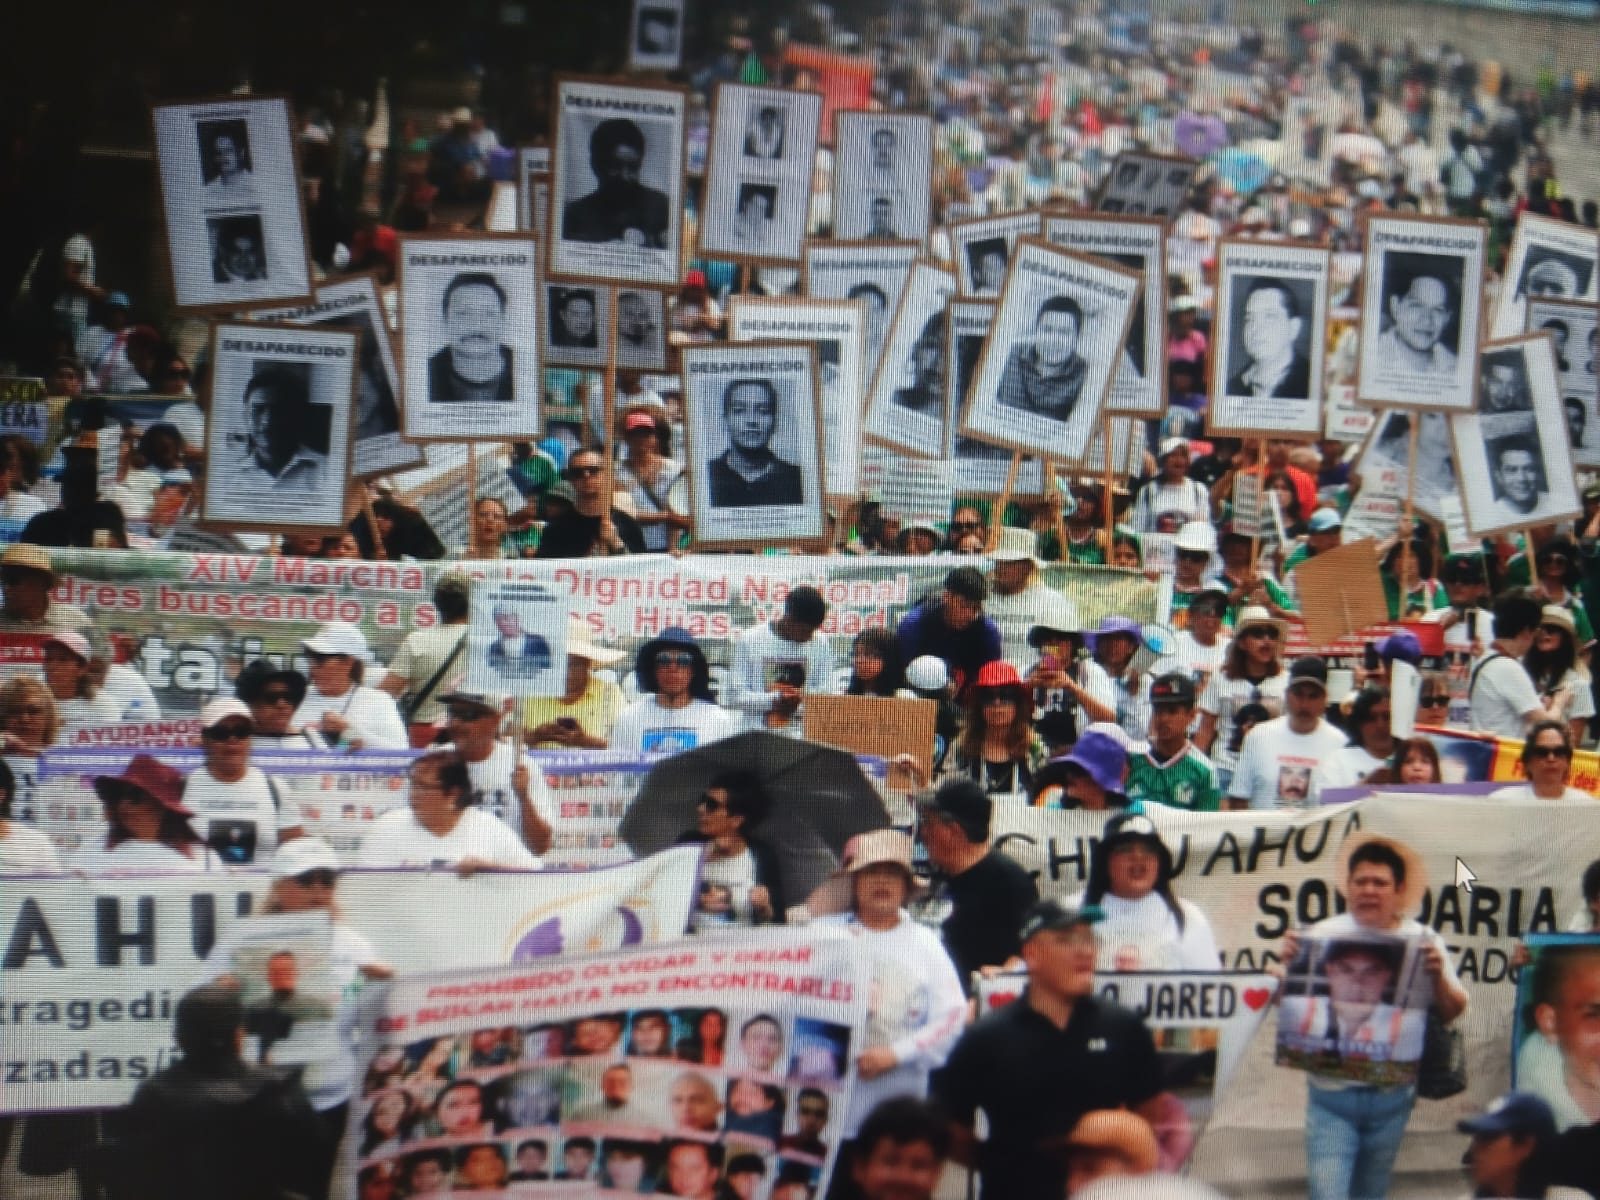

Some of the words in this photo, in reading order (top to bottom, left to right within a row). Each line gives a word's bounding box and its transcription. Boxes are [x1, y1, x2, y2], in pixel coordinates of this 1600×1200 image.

[1375, 233, 1477, 250] DESAPARECIDO
[409, 255, 528, 267] DESAPARECIDO
[1226, 258, 1322, 272] DESAPARECIDO
[1021, 259, 1128, 300] DESAPARECIDO
[222, 339, 348, 357] DESAPARECIDO
[689, 361, 805, 374] DESAPARECIDO
[188, 553, 254, 583] XIV
[272, 556, 425, 590] Marcha
[742, 574, 910, 604] Naional
[160, 585, 363, 623] buscando
[376, 600, 399, 625] a
[1140, 982, 1237, 1021] JARED
